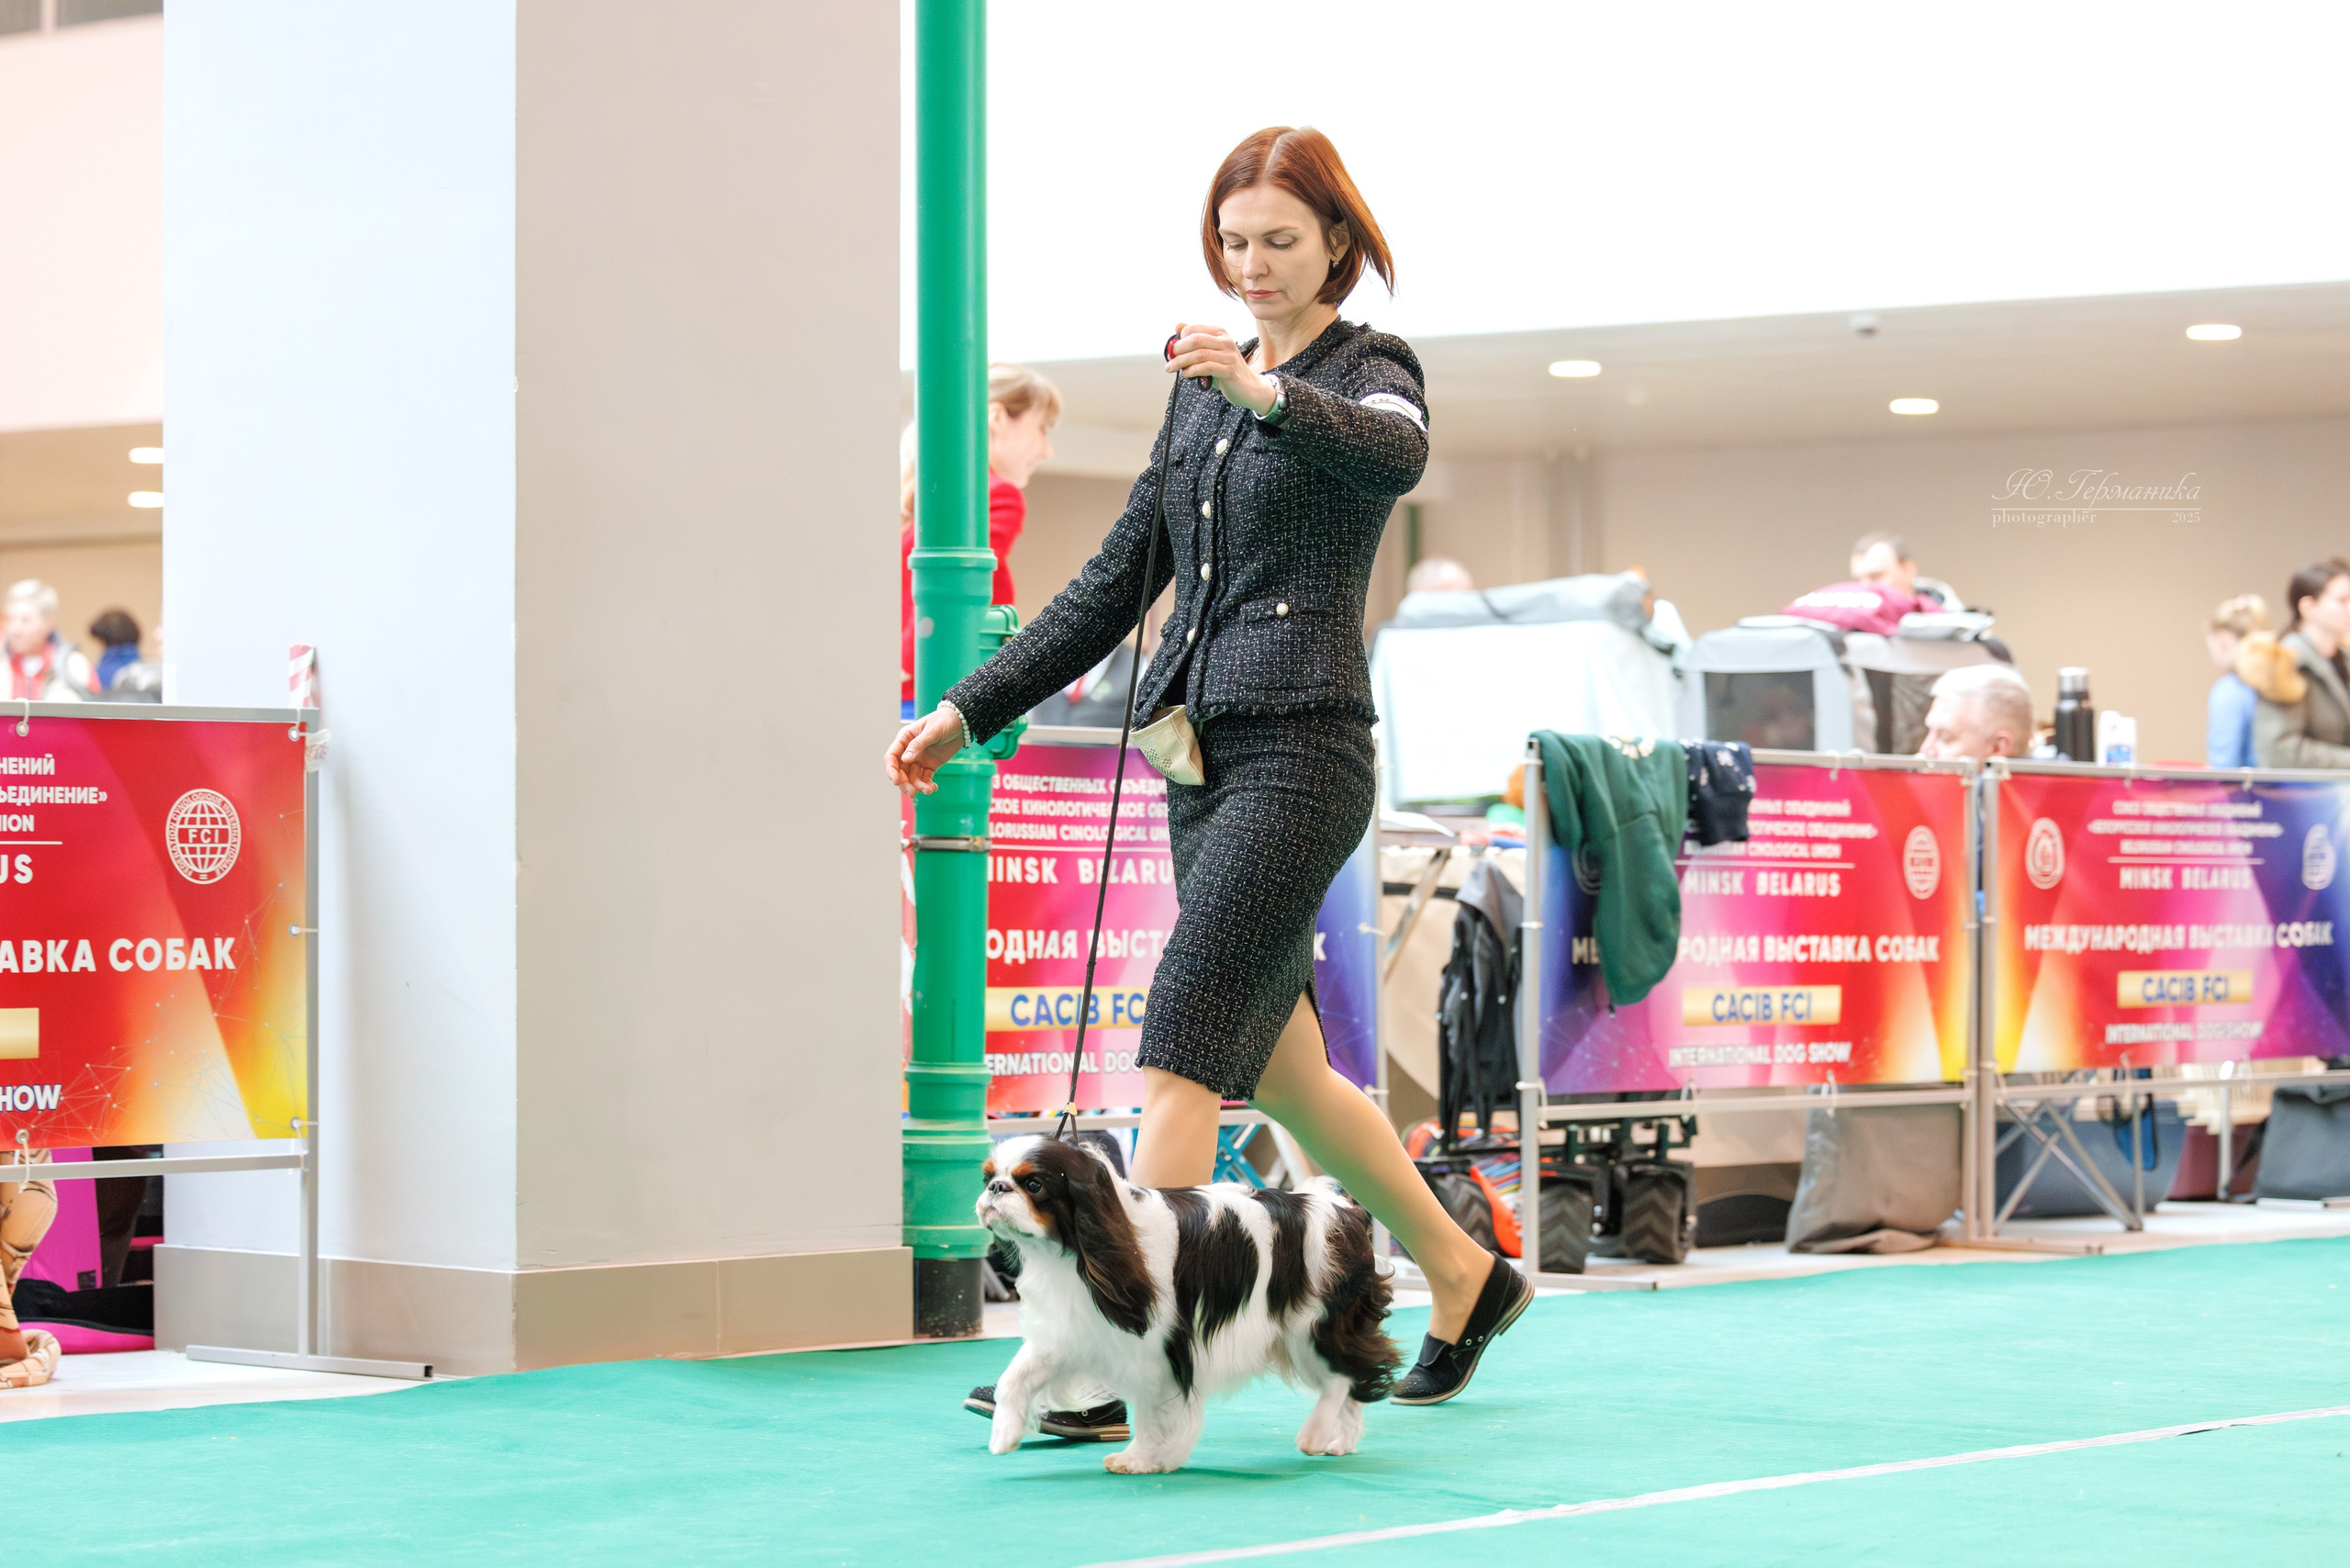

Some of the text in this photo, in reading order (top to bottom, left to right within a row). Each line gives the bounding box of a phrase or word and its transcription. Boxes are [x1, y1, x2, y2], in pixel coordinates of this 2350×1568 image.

[1002, 774, 1107, 794] ОБЩЕСТВЕННЫХ
[0, 814, 35, 832] ION
[188, 829, 219, 844] FCI
[988, 856, 1058, 884] INSK
[1684, 870, 1841, 896] MINSK BELARUS
[0, 937, 236, 973] АВКА СОБАК
[1763, 935, 1872, 962] ВЫСТАВКА
[1874, 935, 1940, 962] СОБАК
[1011, 994, 1100, 1026] CACIB
[1713, 991, 1812, 1023] CACIB FCI
[0, 1084, 62, 1112] HOW
